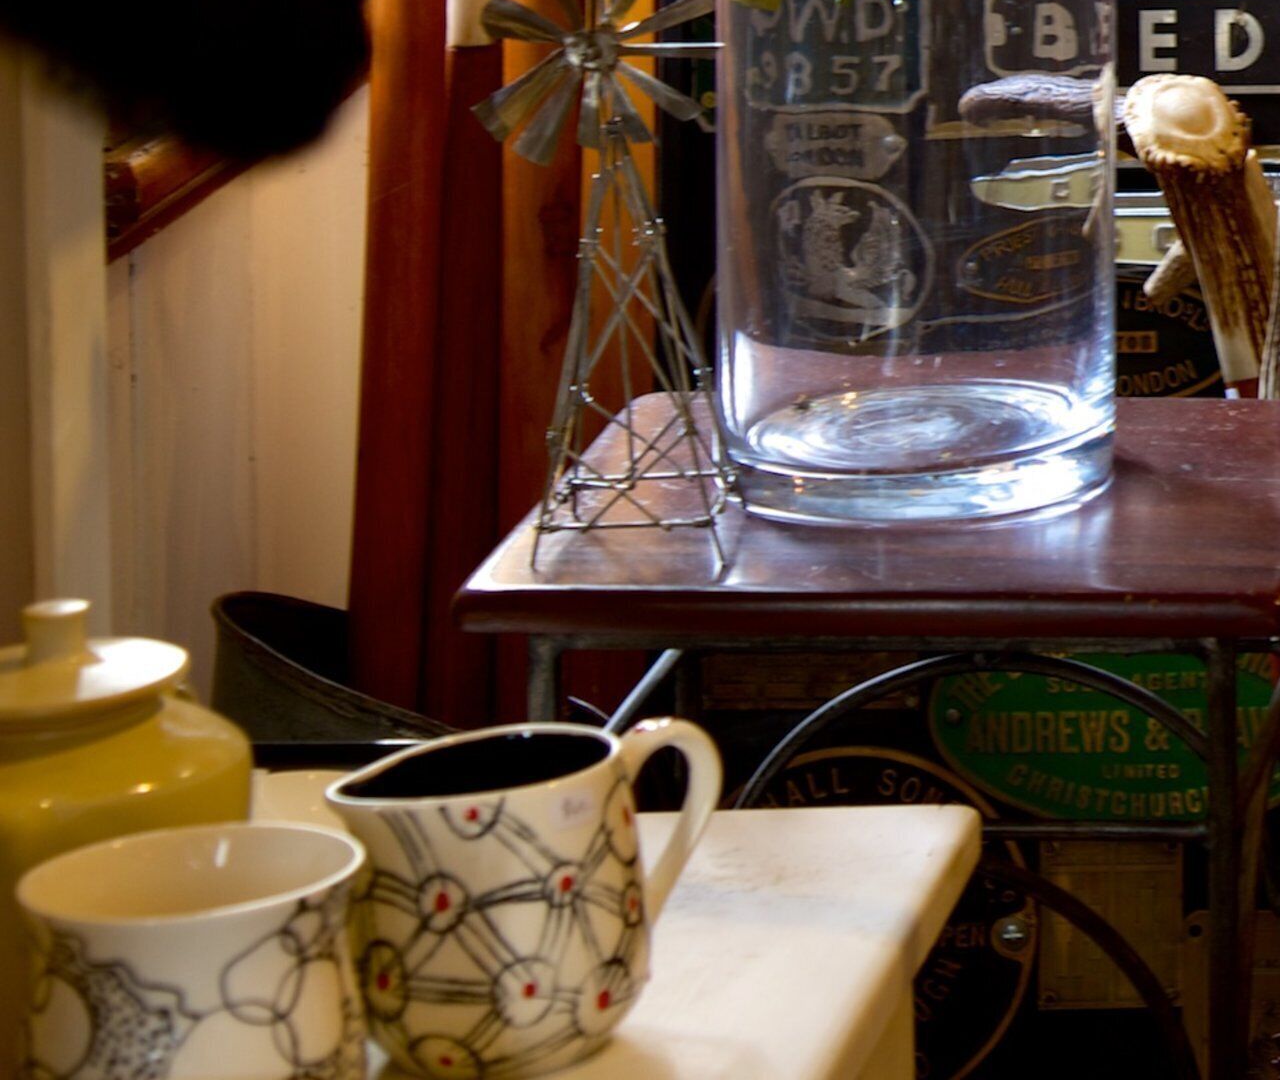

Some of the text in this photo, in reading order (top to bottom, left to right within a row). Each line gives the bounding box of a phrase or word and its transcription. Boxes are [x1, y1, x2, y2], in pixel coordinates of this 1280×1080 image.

[1116, 360, 1198, 396] ONDON
[964, 708, 1132, 755] ANDREWS
[1143, 716, 1172, 753] &
[1100, 763, 1183, 781] LIMITED
